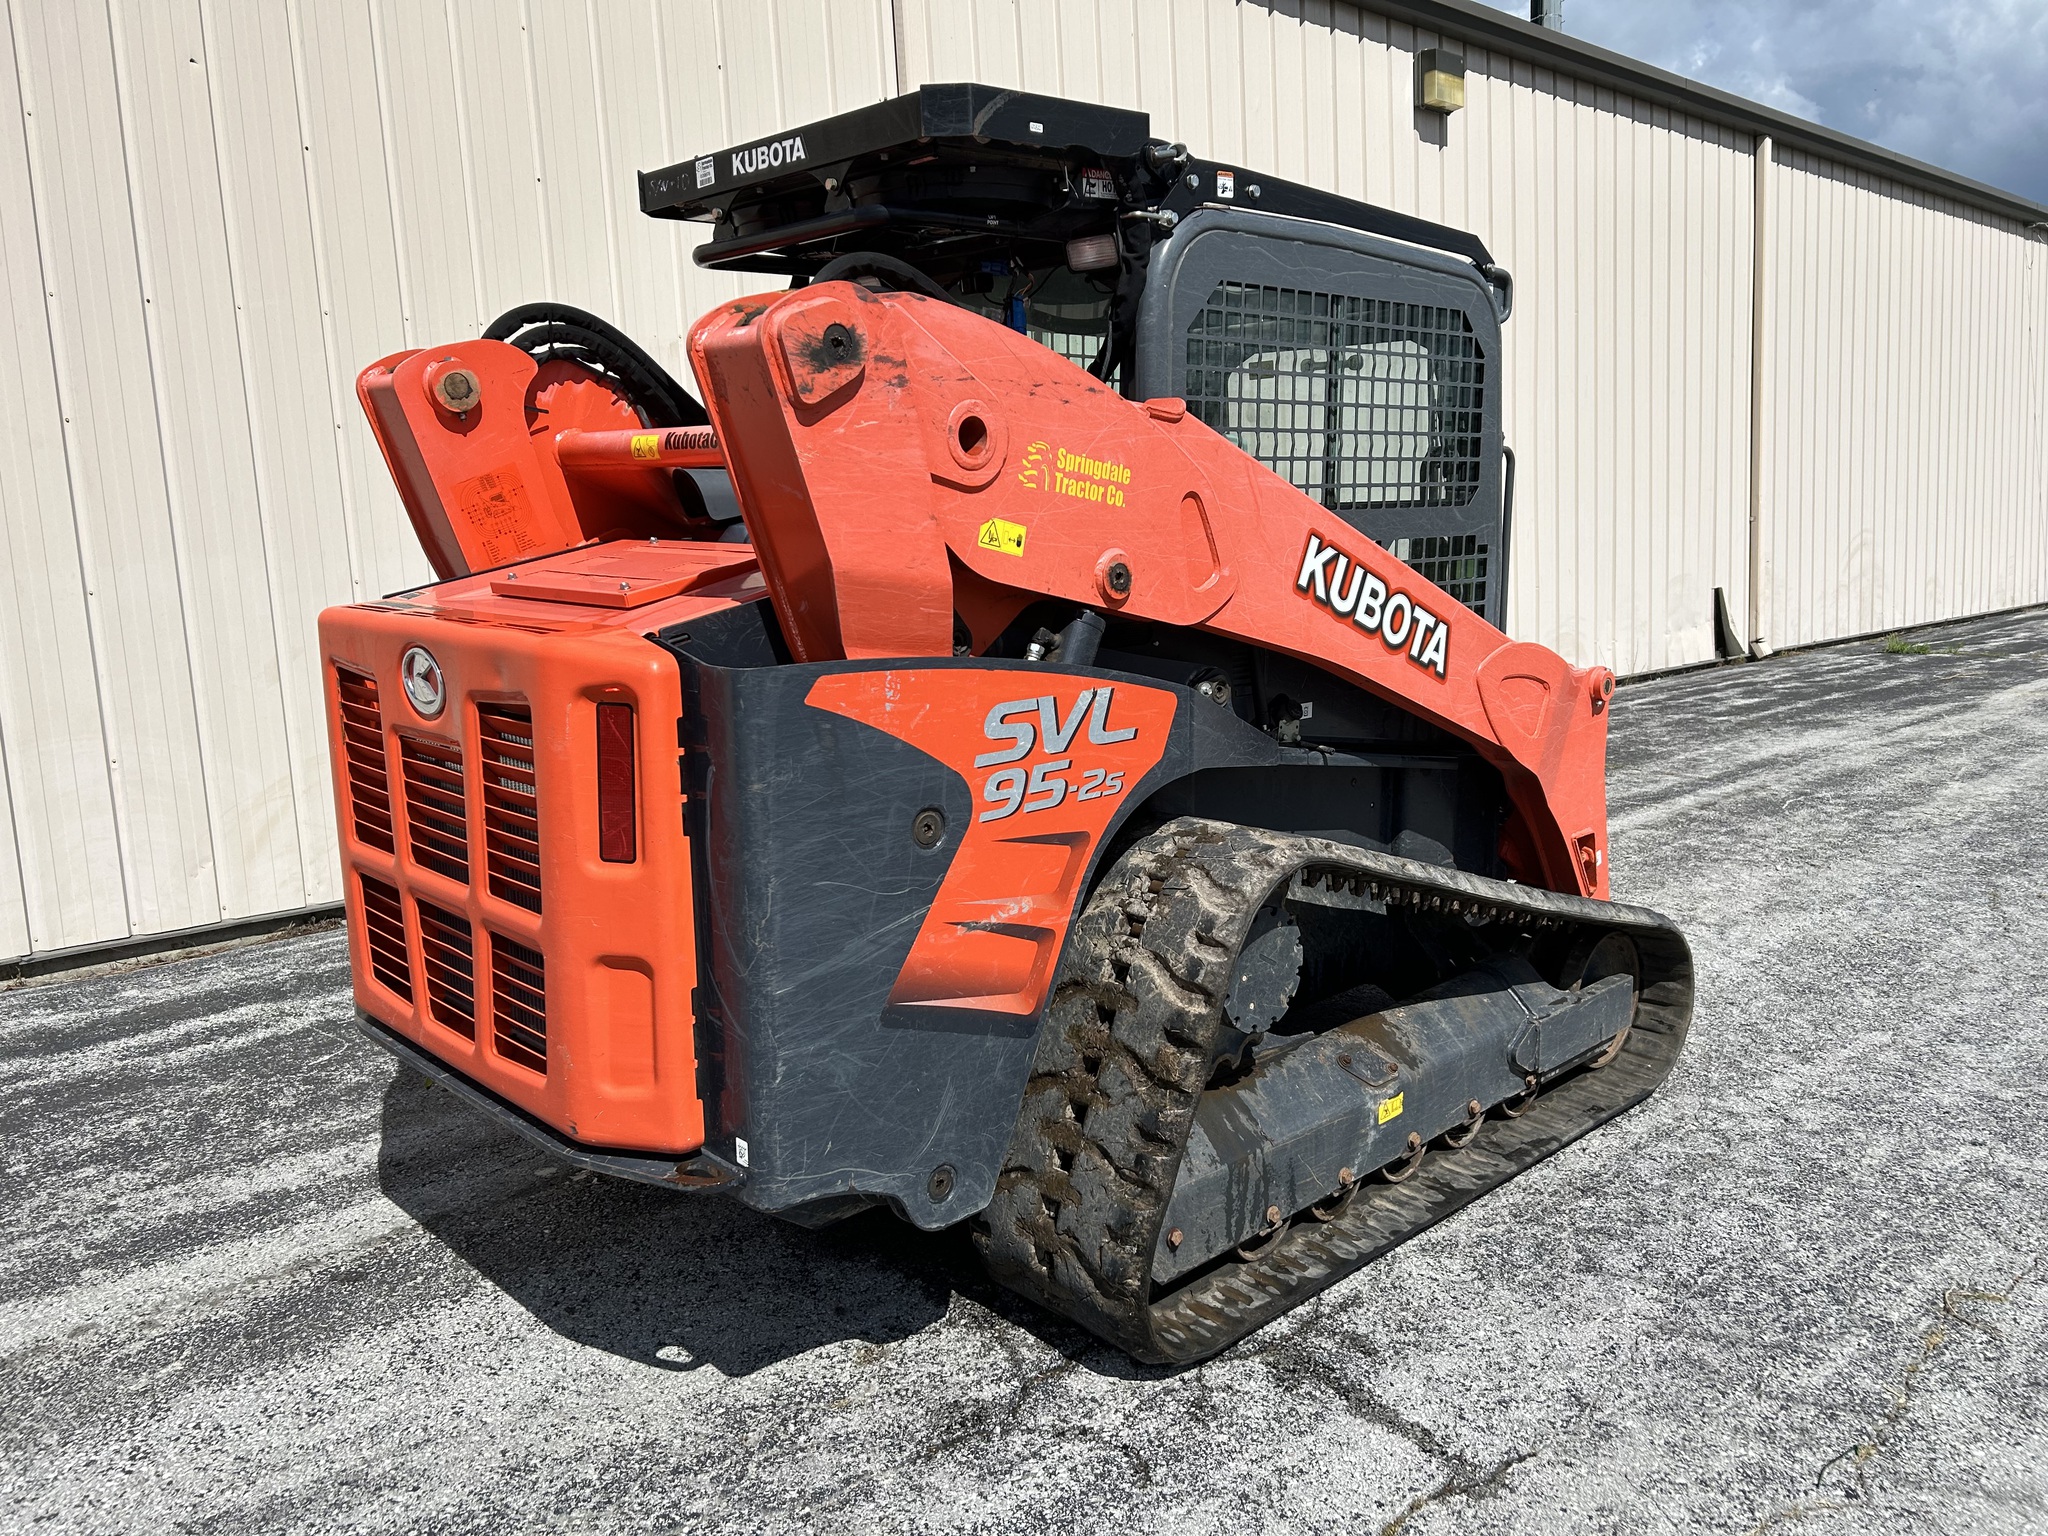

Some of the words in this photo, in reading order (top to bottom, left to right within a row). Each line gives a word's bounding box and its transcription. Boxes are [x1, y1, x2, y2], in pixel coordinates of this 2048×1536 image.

[732, 136, 806, 176] KUBOTA
[1056, 447, 1132, 485] Springdale
[1055, 471, 1105, 503] Tractor
[1106, 484, 1126, 508] Co.
[1297, 534, 1449, 677] KUBOTA
[973, 685, 1139, 768] SVL
